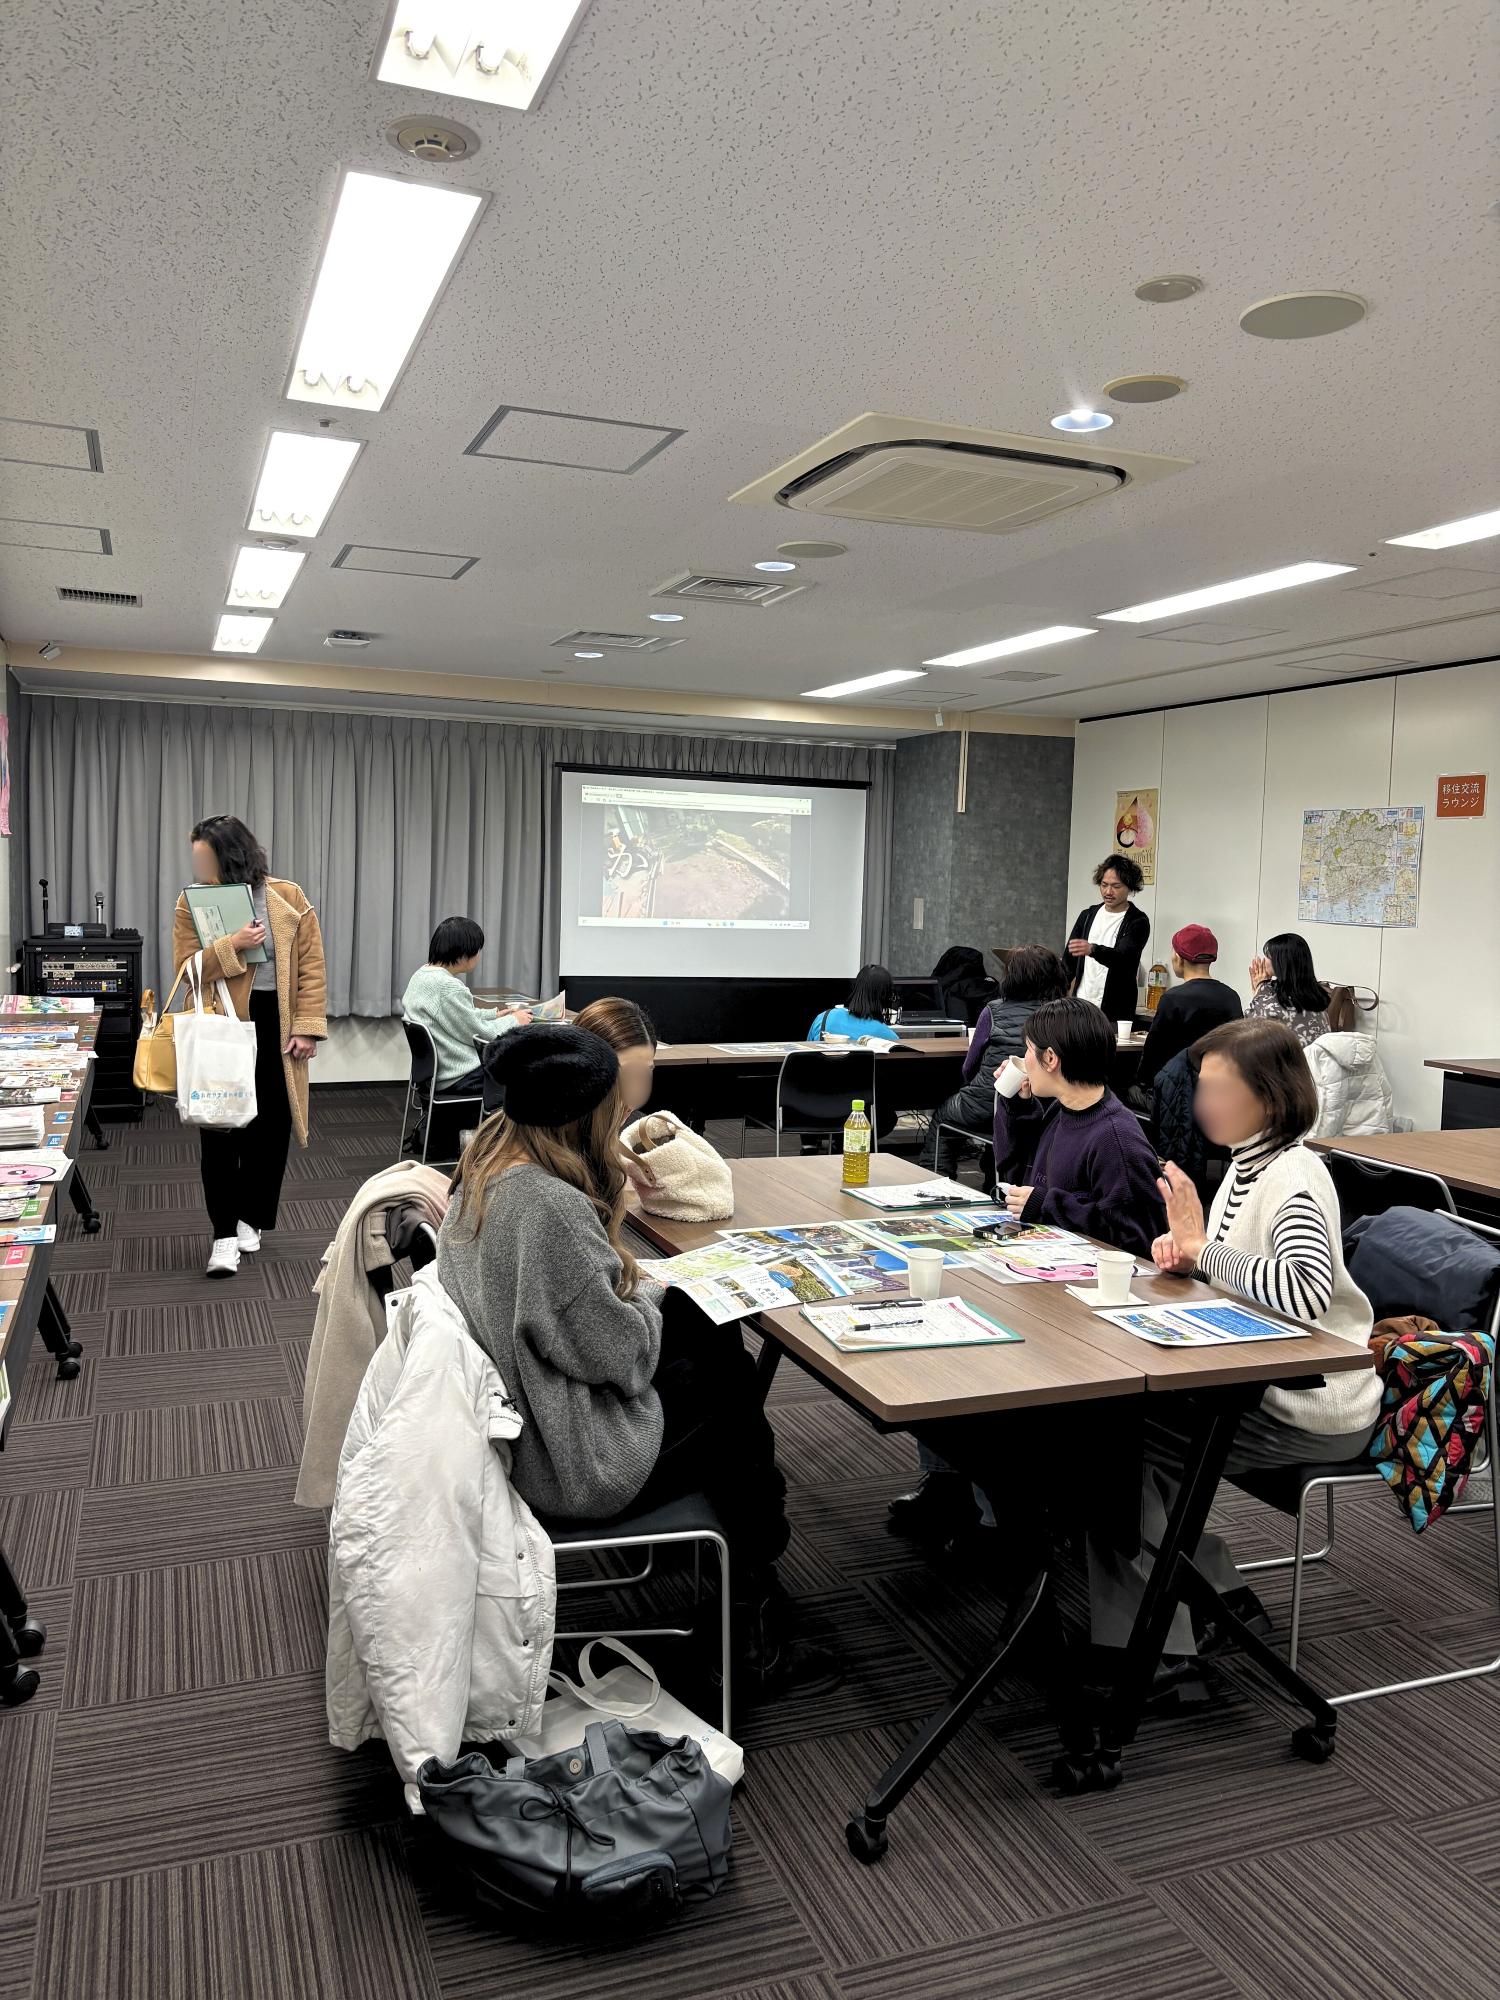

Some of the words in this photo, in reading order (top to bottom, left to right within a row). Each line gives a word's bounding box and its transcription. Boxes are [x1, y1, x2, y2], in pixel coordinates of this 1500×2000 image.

[1442, 783, 1480, 795] 移住交流
[1442, 797, 1480, 808] ラウンジ
